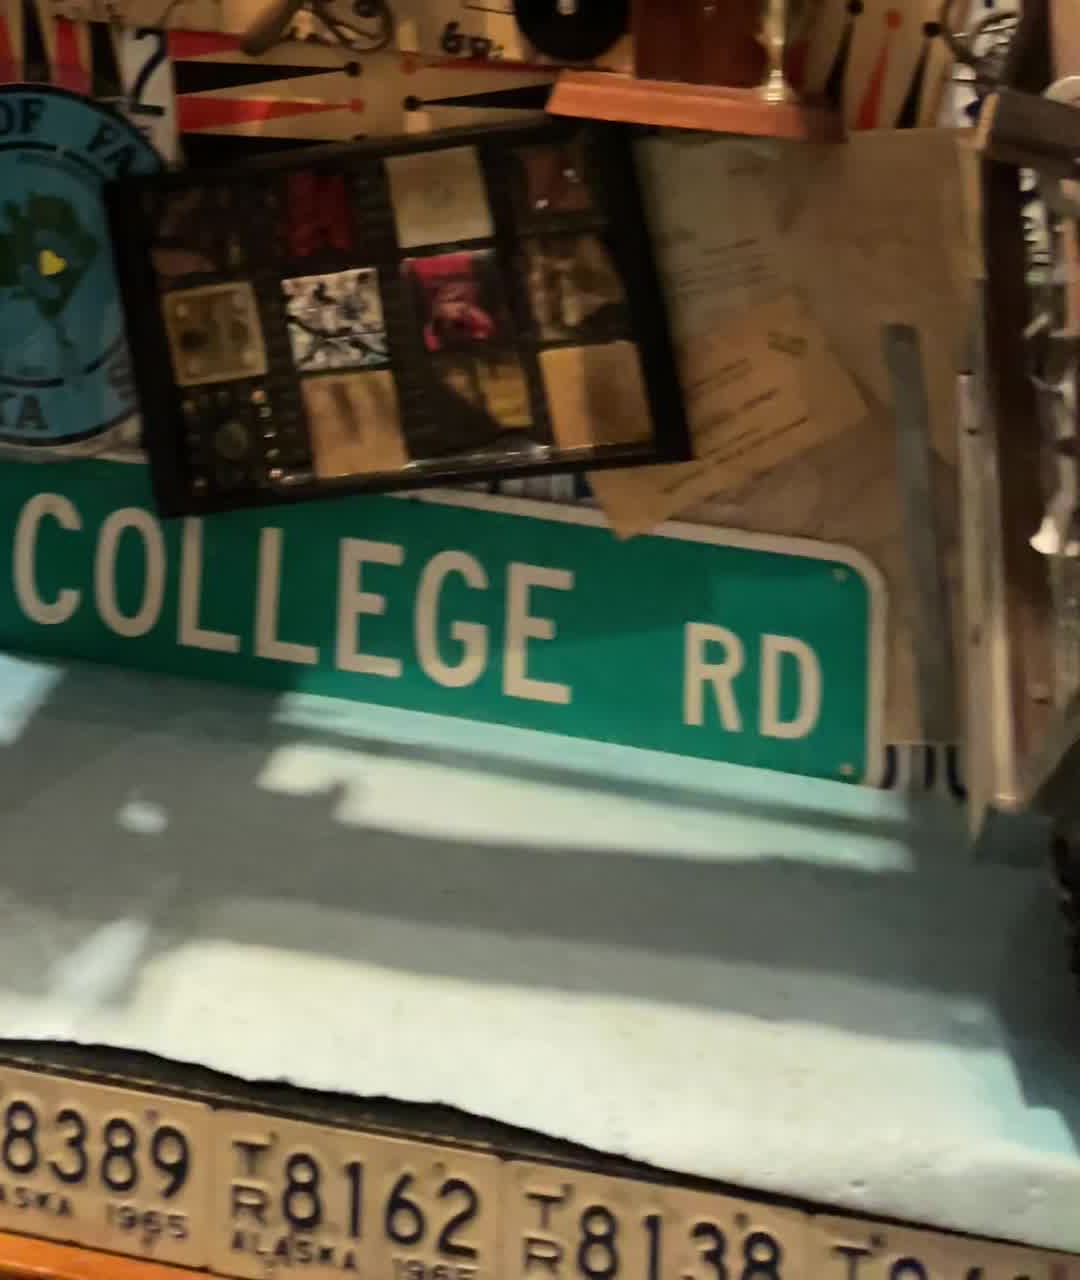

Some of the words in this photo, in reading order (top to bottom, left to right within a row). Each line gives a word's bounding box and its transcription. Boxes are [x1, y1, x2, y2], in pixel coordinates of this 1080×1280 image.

[12, 490, 575, 706] COLLEGE
[681, 620, 824, 743] RD
[2, 1099, 190, 1200] 8389
[229, 1229, 360, 1273] ALASKA
[282, 1151, 482, 1260] 8162
